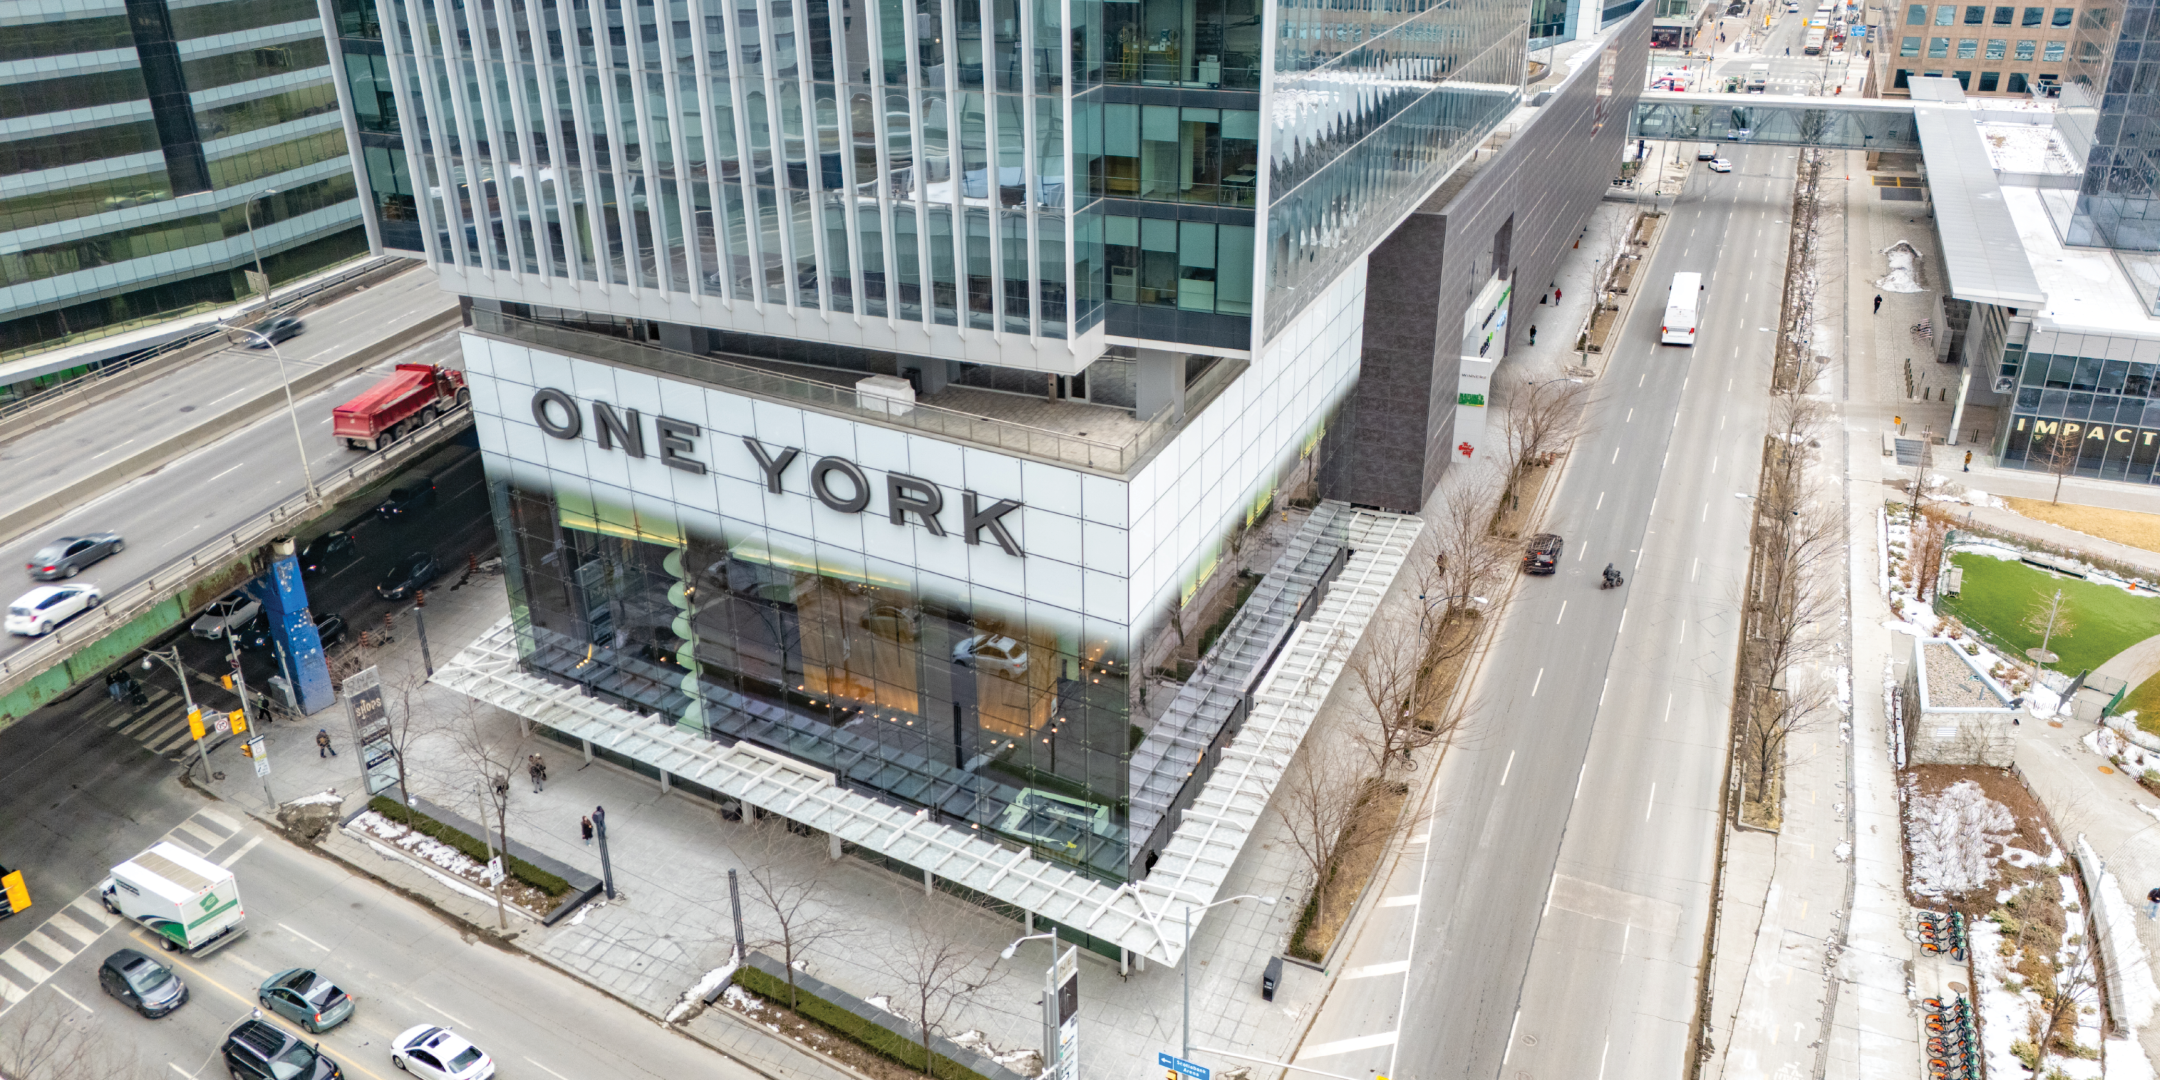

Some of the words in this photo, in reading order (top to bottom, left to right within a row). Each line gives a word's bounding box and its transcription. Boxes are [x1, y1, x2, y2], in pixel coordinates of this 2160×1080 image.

[2016, 418, 2157, 446] IMPACT
[531, 387, 706, 476] ONE
[742, 435, 1026, 558] YORK
[355, 697, 382, 720] SHOPS
[1176, 1060, 1207, 1075] Scotiabank
[1182, 1067, 1200, 1078] Arena
